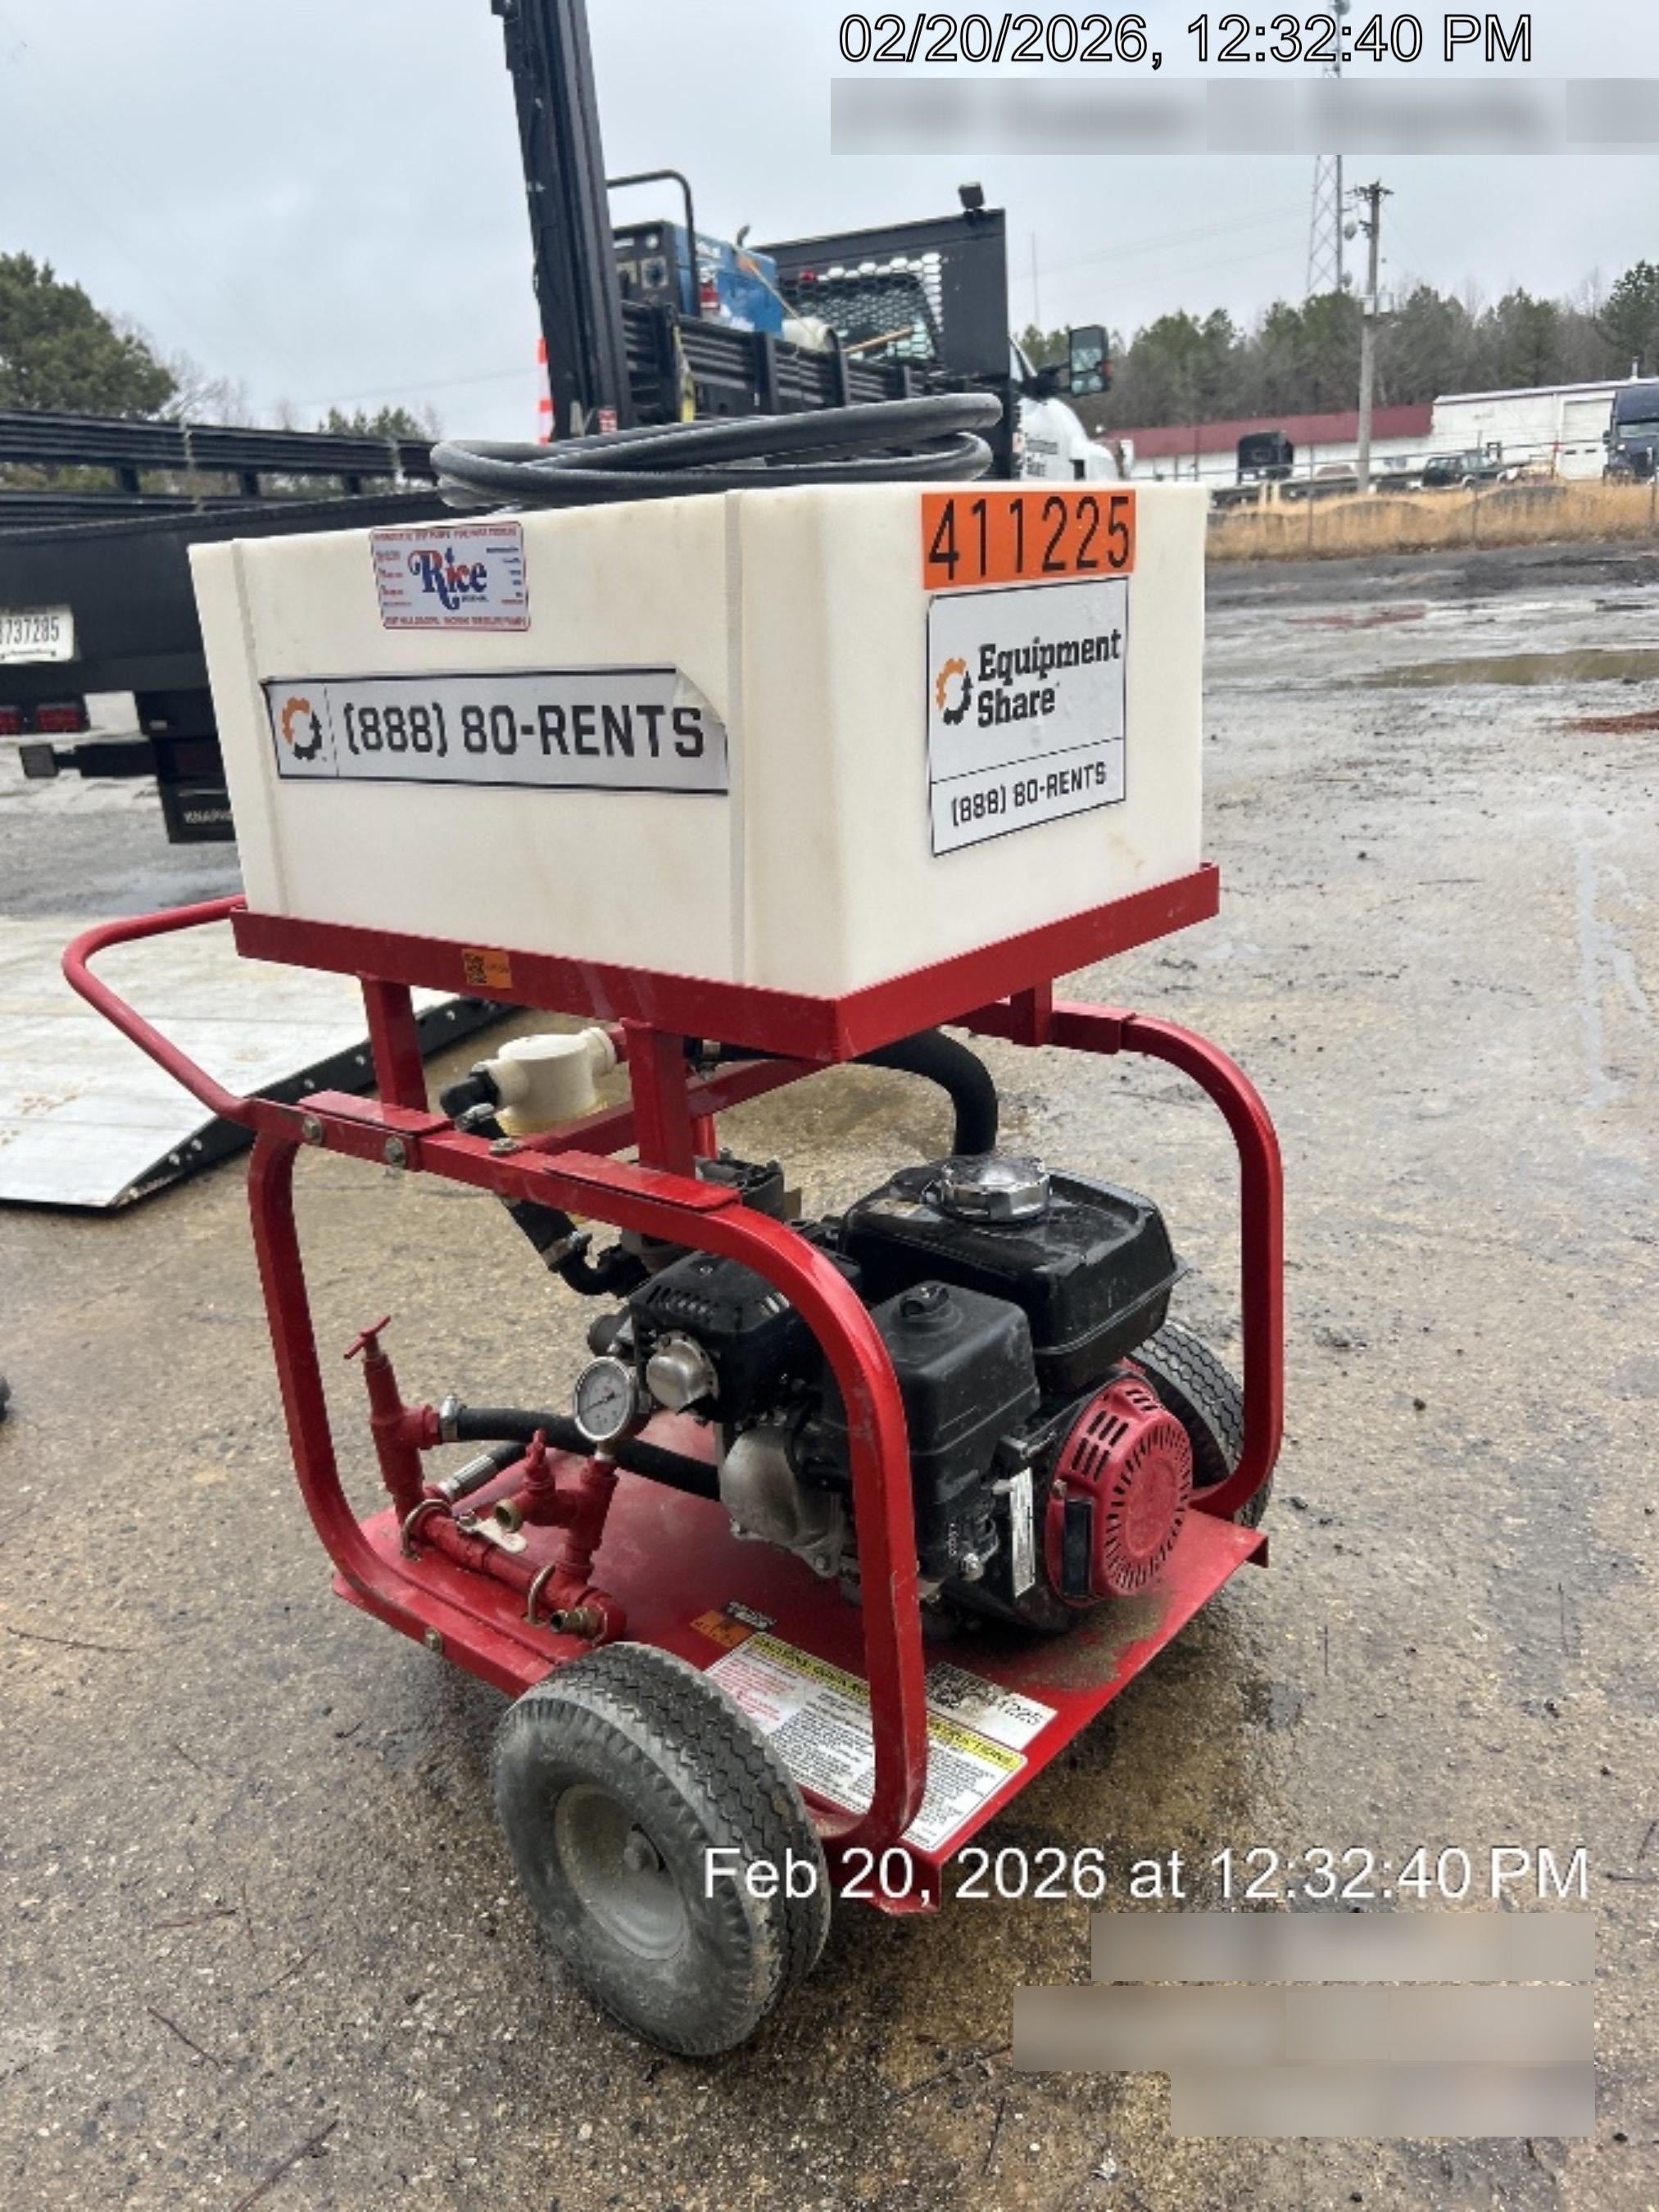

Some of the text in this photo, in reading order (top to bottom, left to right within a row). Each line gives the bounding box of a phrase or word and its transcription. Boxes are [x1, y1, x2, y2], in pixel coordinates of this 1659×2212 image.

[929, 494, 1130, 581] 411225
[407, 546, 487, 610] Rice
[0, 616, 59, 645] 737285
[977, 628, 1122, 688] Equipment
[343, 701, 705, 759] (888) 80-RENTS
[977, 685, 1055, 728] Share
[950, 761, 1107, 827] (888) 80-RENTS
